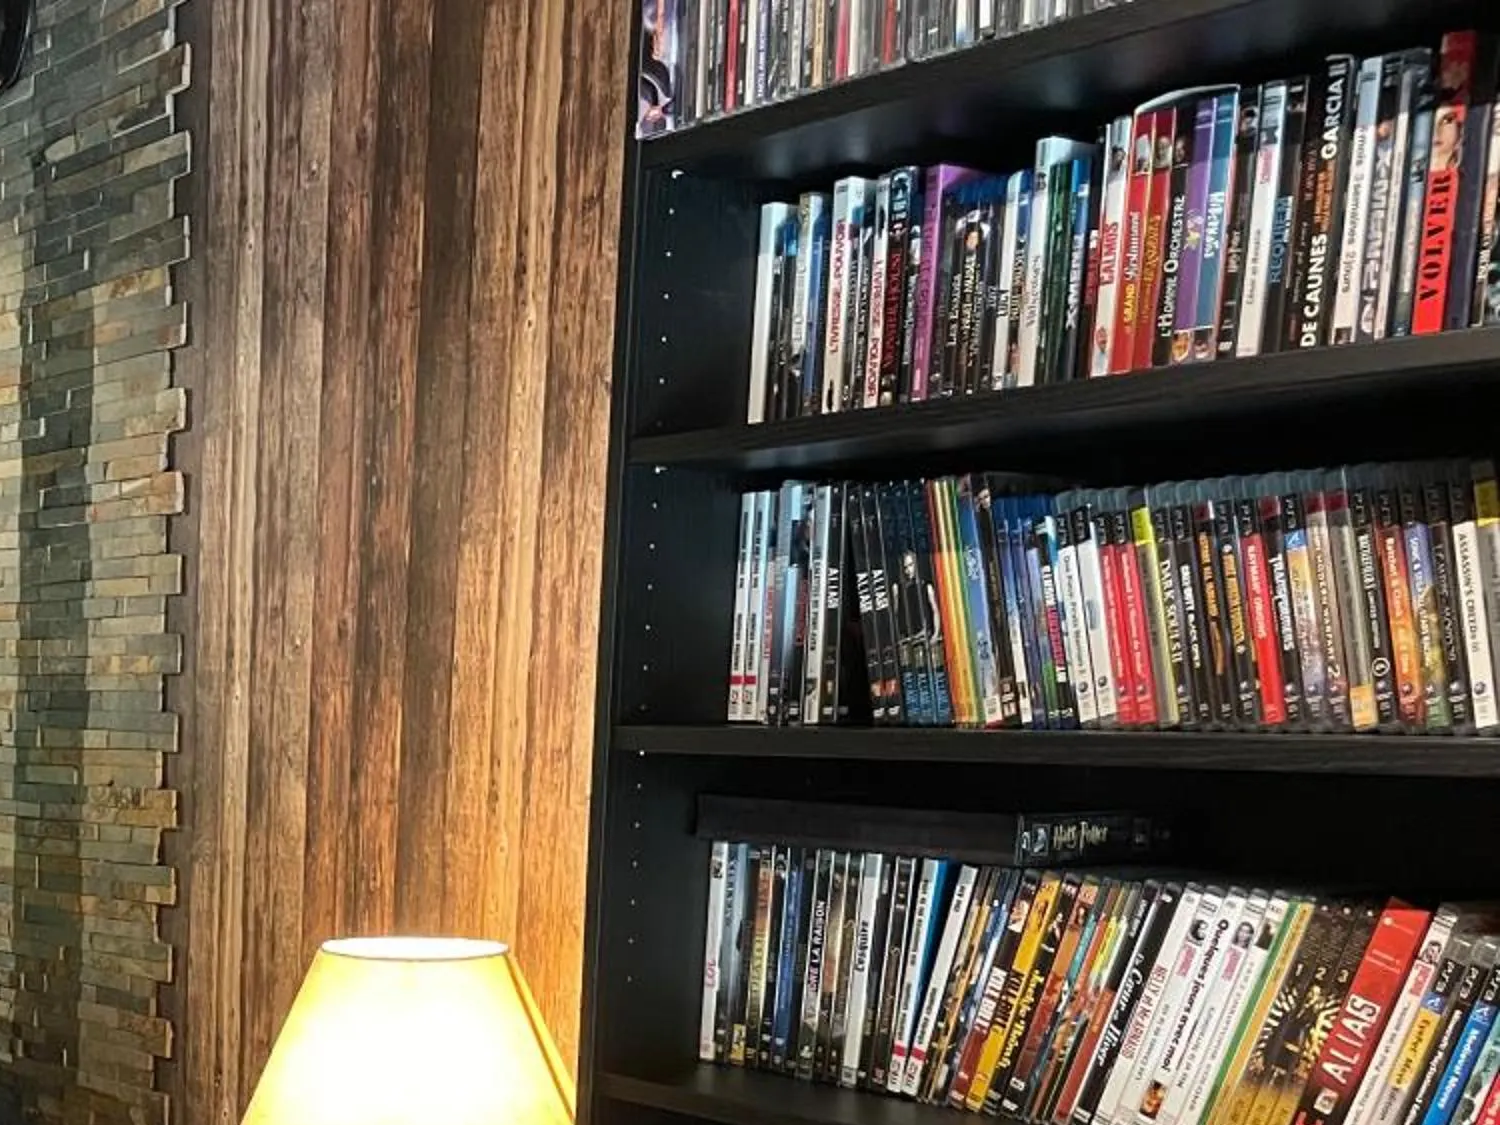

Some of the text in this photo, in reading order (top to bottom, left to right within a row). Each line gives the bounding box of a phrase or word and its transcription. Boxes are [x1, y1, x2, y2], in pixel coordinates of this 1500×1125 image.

[1321, 80, 1347, 160] GARCIA
[1099, 222, 1118, 287] CALMOS
[1420, 173, 1452, 302] VOLVER
[1303, 233, 1328, 318] CAUNES
[1300, 321, 1318, 347] DE
[826, 567, 840, 610] ALIAS
[856, 572, 874, 613] ALIAS
[872, 569, 889, 612] ALIAS
[1159, 560, 1174, 601] DARK
[1459, 533, 1475, 596] ASSASSIN'S
[1166, 604, 1182, 650] SOULS
[1269, 553, 1295, 651] TRANSFORMERS
[1316, 555, 1328, 605] MODERN
[1327, 664, 1341, 678] 2
[975, 966, 1007, 1027] KILL BILL
[992, 969, 1024, 1030] KILL BILL
[1016, 969, 1044, 1018] Jackie
[1160, 918, 1230, 1072] Quelques jours avec moi
[1294, 963, 1304, 977] 1
[1314, 966, 1325, 981] 2
[1337, 969, 1349, 983] 3
[1321, 994, 1381, 1085] ALIAS
